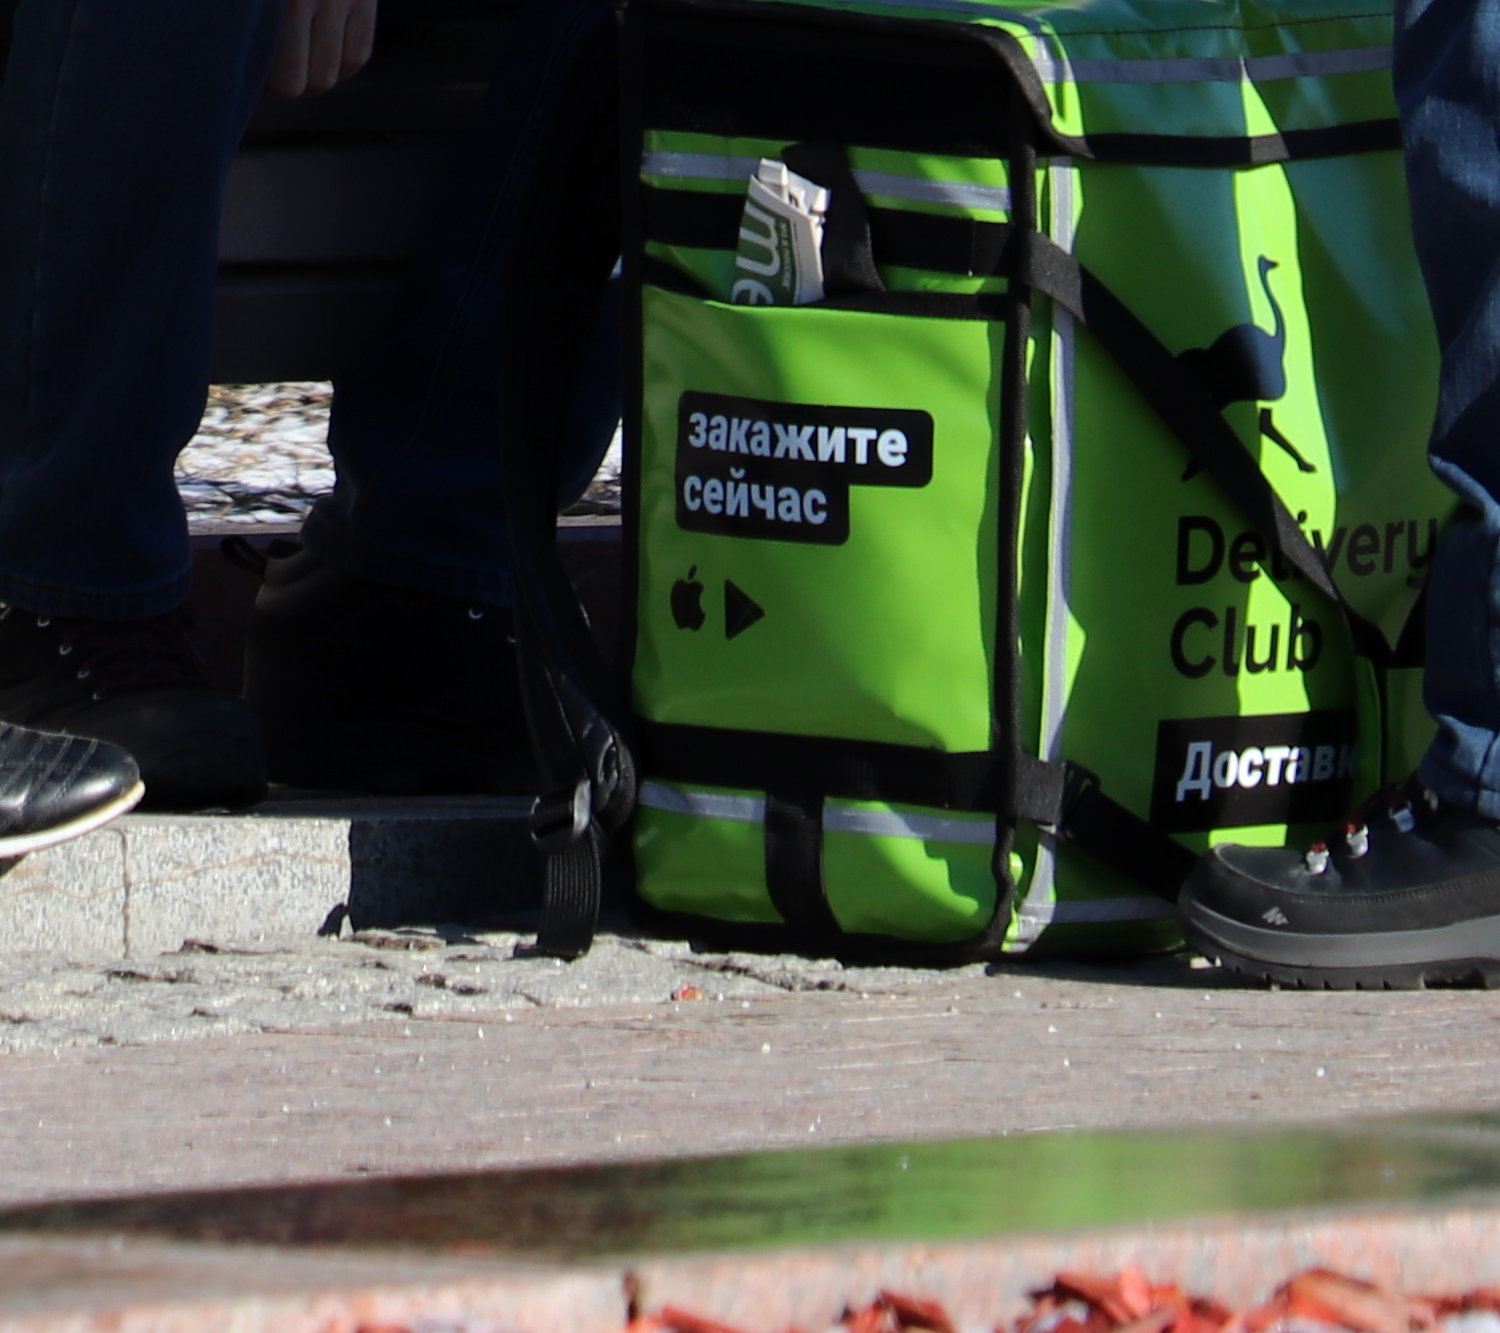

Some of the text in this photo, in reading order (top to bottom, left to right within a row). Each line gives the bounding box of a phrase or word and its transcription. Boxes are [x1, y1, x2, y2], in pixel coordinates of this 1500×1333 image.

[686, 408, 909, 470] закажите
[683, 467, 829, 526] сейчас
[1170, 603, 1323, 679] Club
